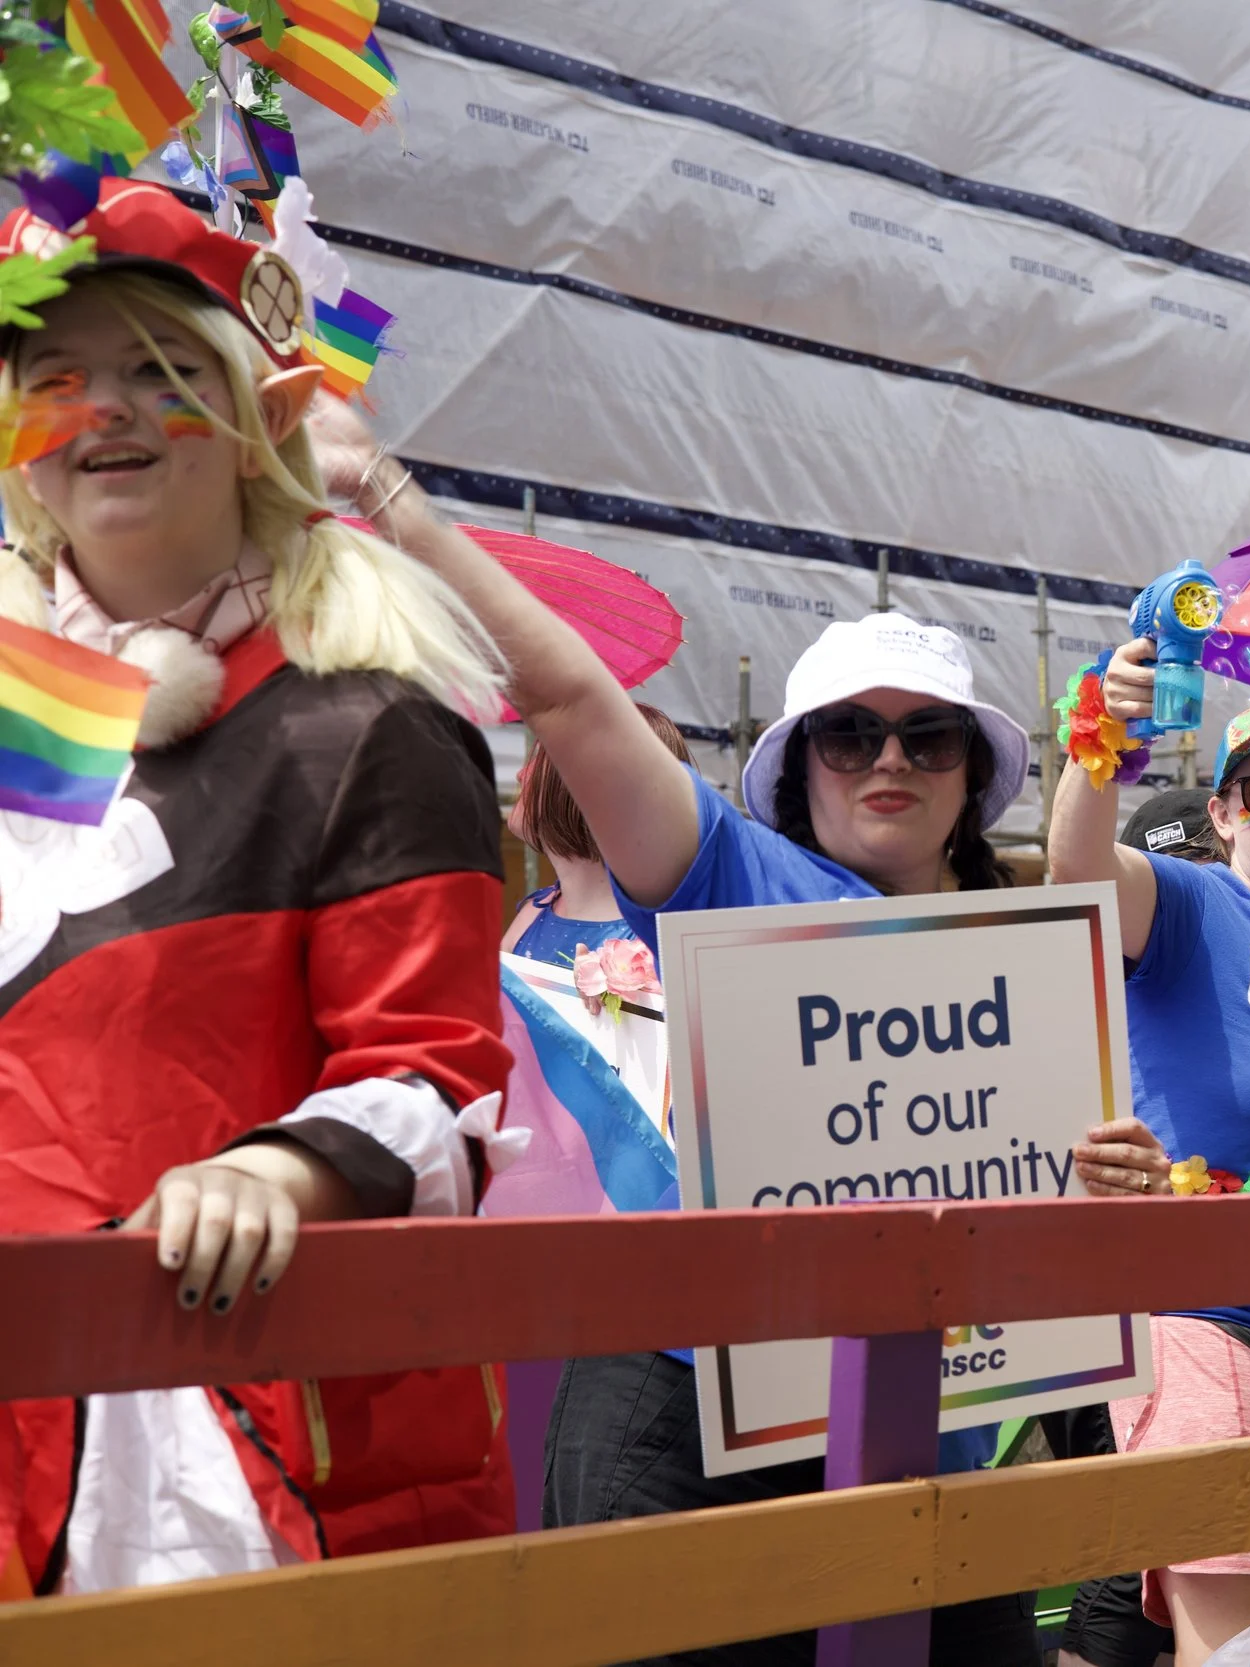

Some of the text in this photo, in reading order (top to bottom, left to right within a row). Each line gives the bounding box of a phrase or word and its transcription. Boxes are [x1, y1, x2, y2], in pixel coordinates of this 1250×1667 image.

[1157, 828, 1181, 842] CATCH
[798, 975, 1011, 1067] Proud
[827, 1080, 998, 1145] of our
[752, 1137, 1074, 1208] community
